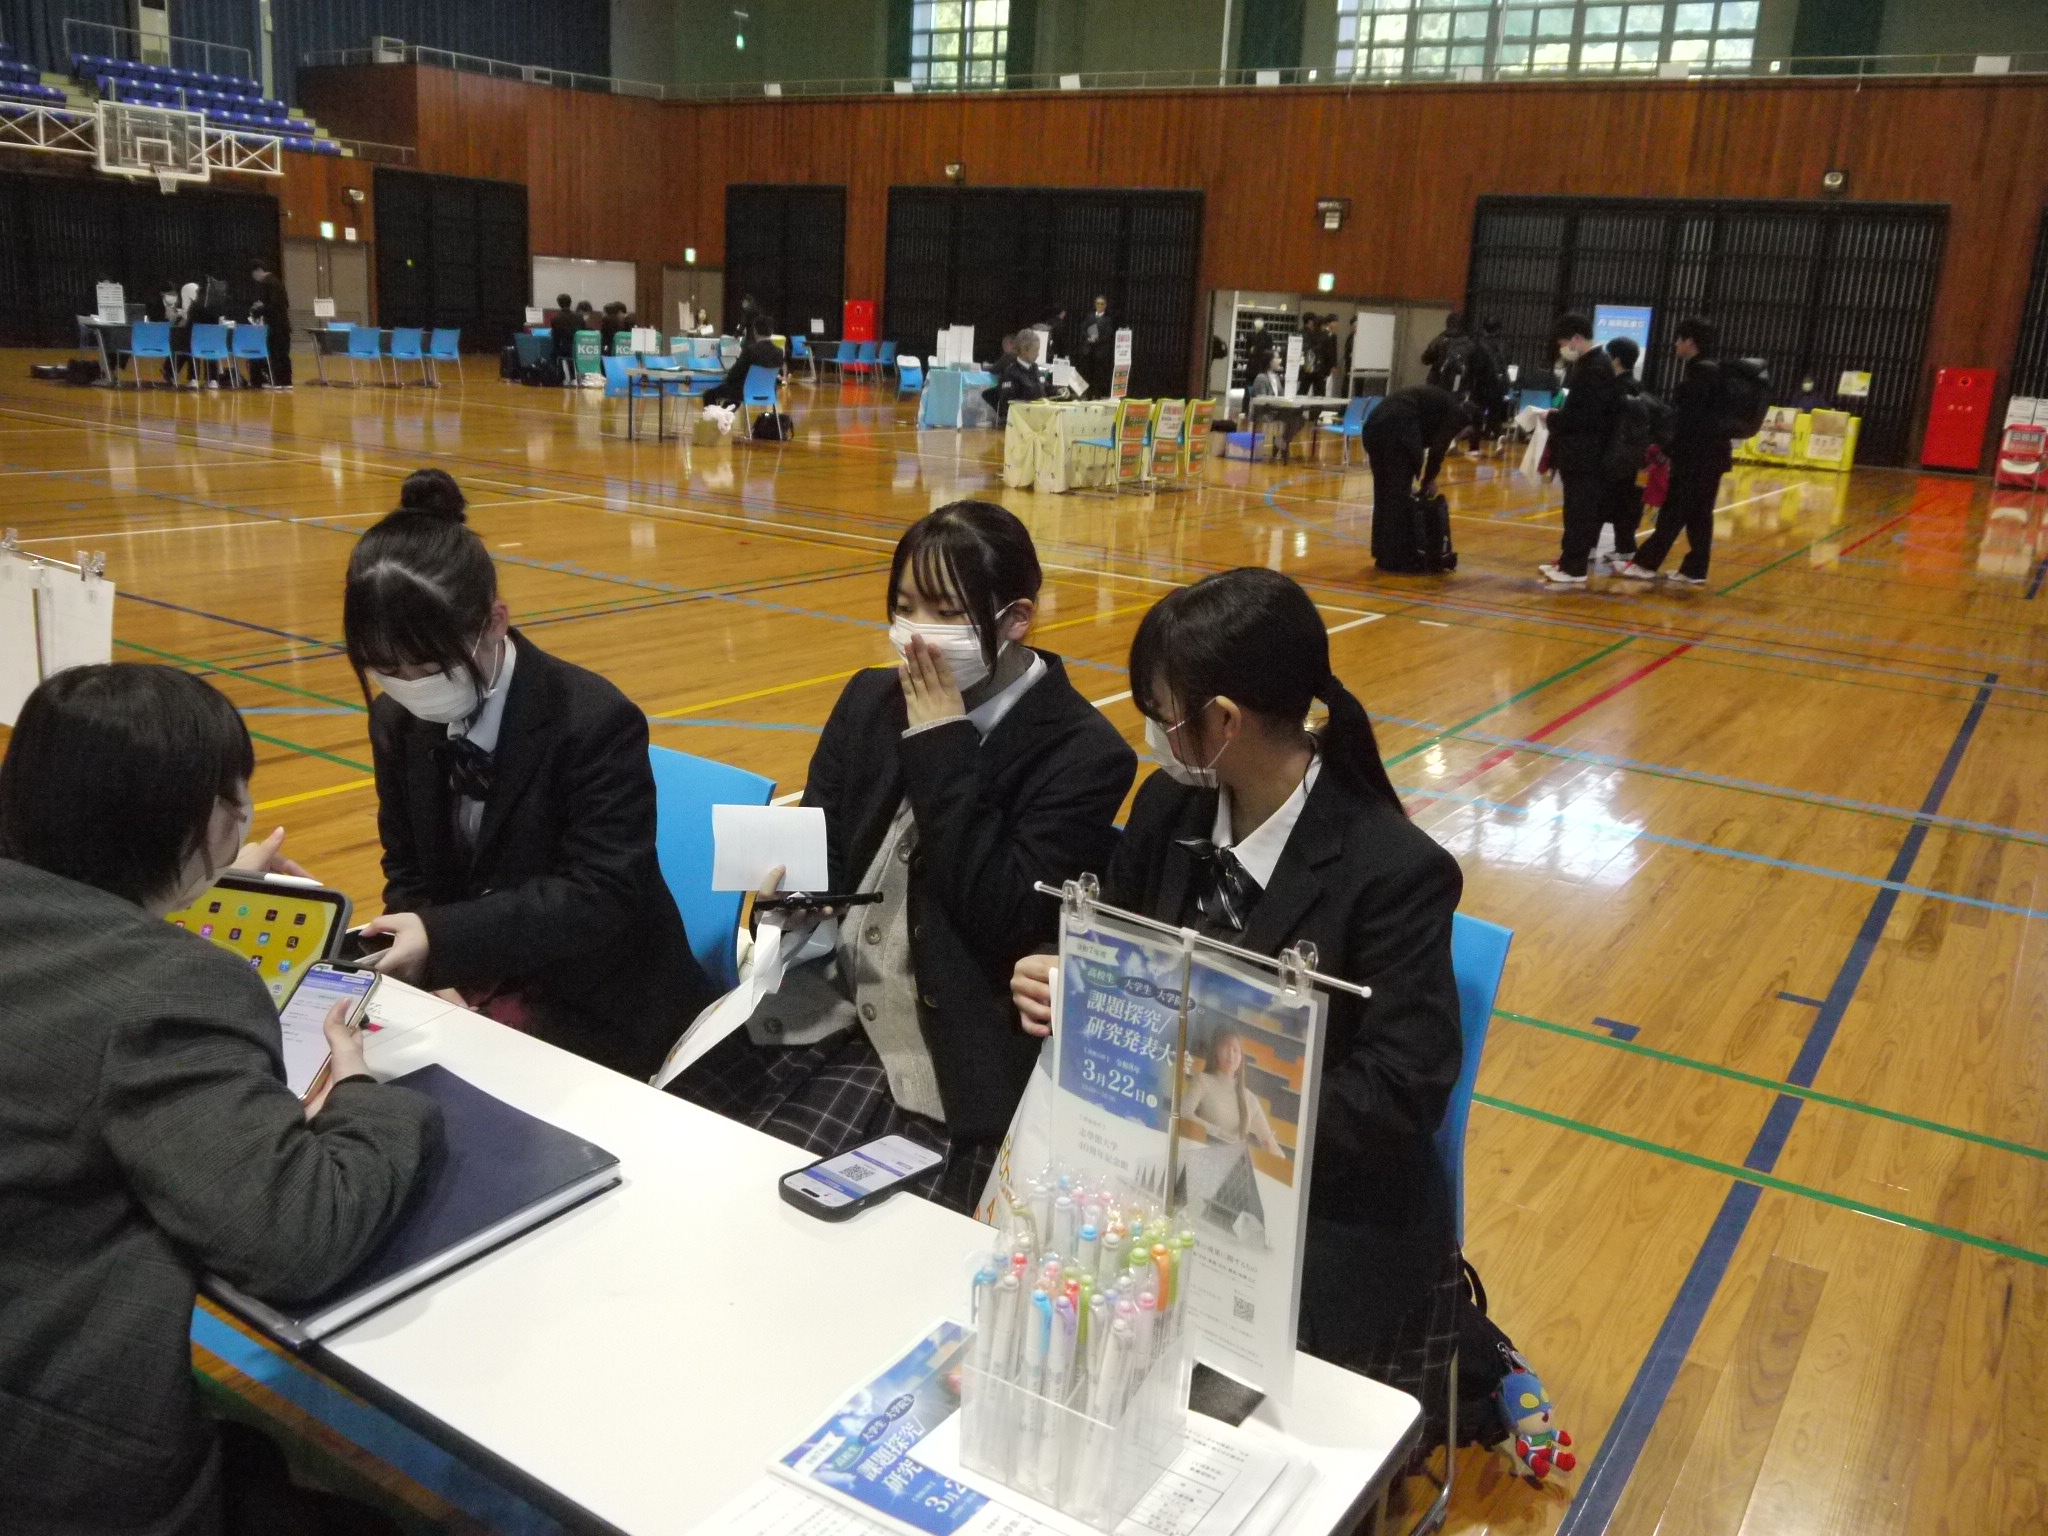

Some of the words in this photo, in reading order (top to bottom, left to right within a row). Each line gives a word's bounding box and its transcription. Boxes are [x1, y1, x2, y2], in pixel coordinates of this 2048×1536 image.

[1087, 966, 1114, 982] 高校生
[1125, 979, 1153, 995] 大学生
[882, 1458, 924, 1493] 研究
